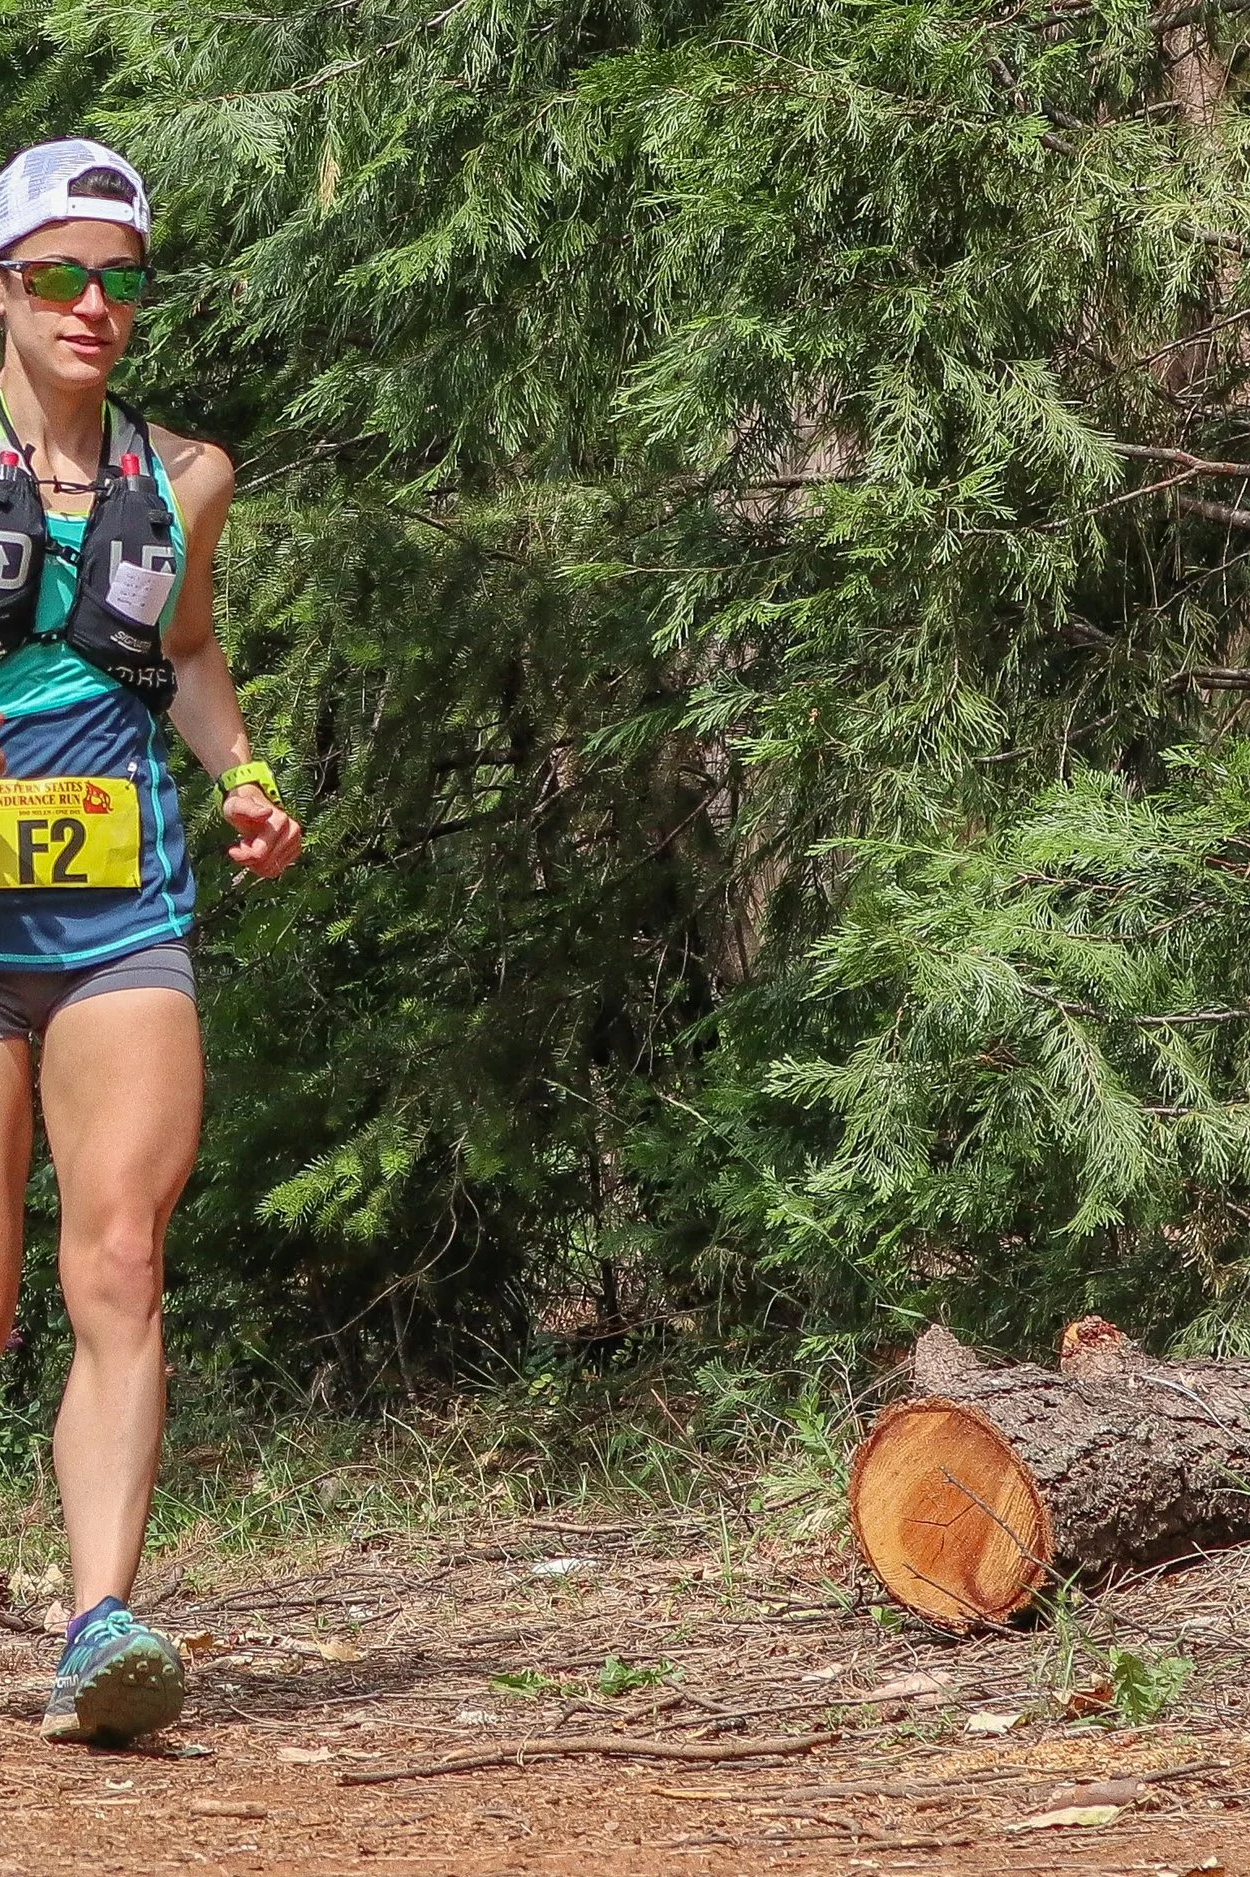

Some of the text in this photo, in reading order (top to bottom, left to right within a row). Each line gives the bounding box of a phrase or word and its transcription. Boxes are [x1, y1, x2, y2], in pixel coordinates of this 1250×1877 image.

[44, 781, 83, 793] STATES
[59, 793, 81, 805] RUN
[17, 817, 89, 885] F2
